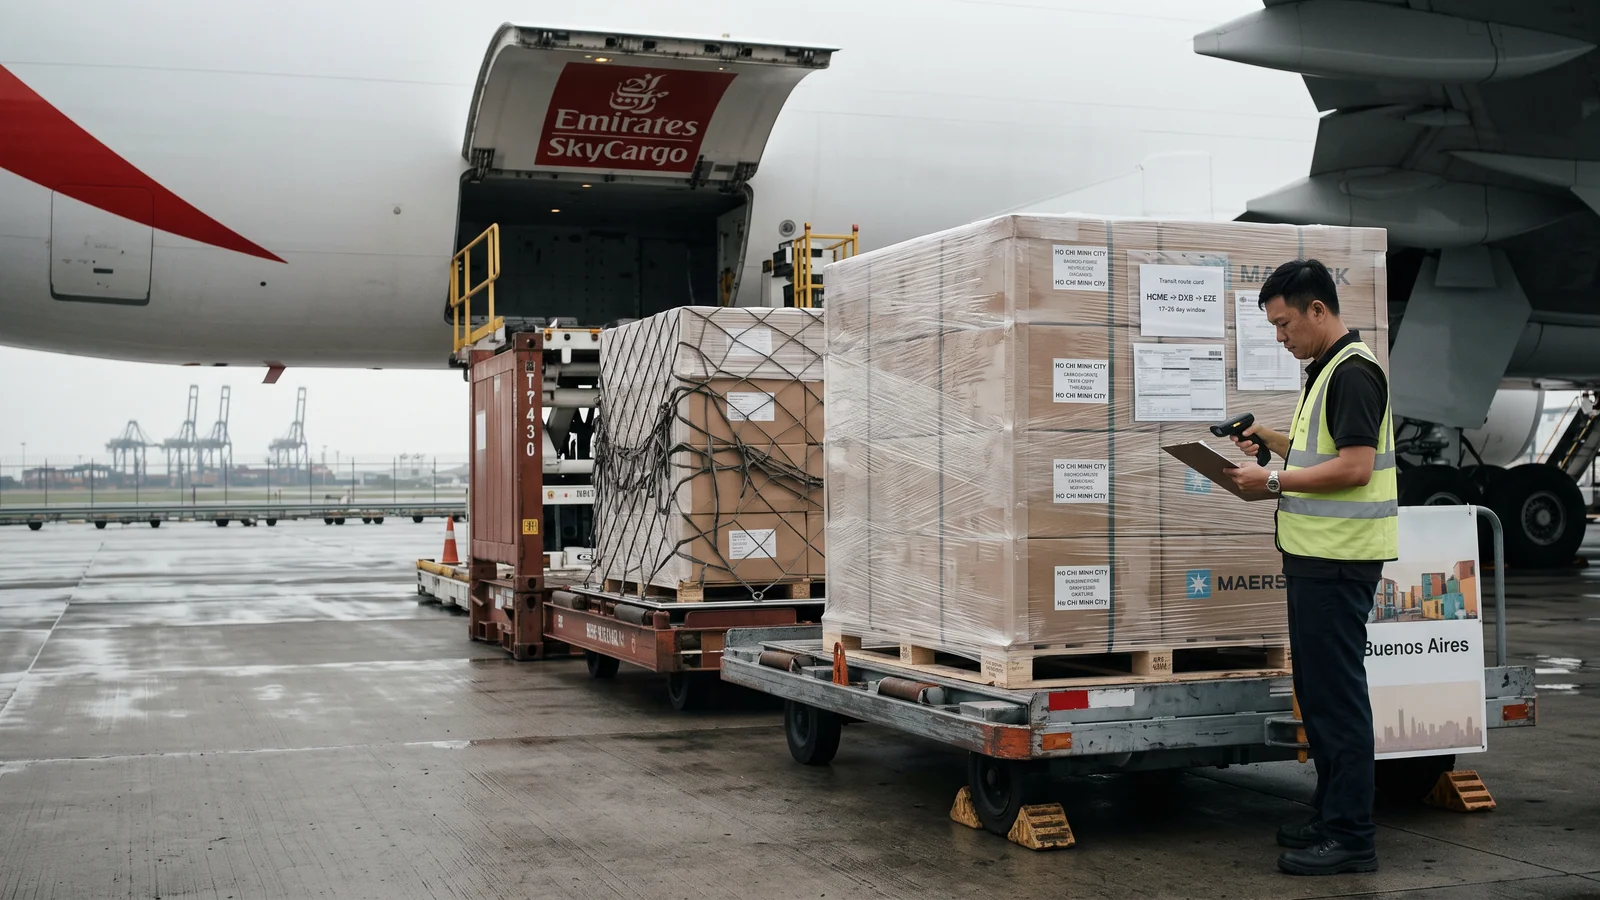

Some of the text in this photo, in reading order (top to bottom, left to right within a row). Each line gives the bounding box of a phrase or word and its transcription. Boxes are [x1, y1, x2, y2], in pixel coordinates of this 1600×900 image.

[554, 108, 699, 136] Emirates
[547, 137, 689, 166] SkyCargo
[1178, 294, 1193, 302] DXB
[526, 373, 535, 457] T7430
[1217, 574, 1287, 591] MAERS
[1094, 598, 1108, 606] CITY
[1364, 637, 1469, 656] Buenos Aires
